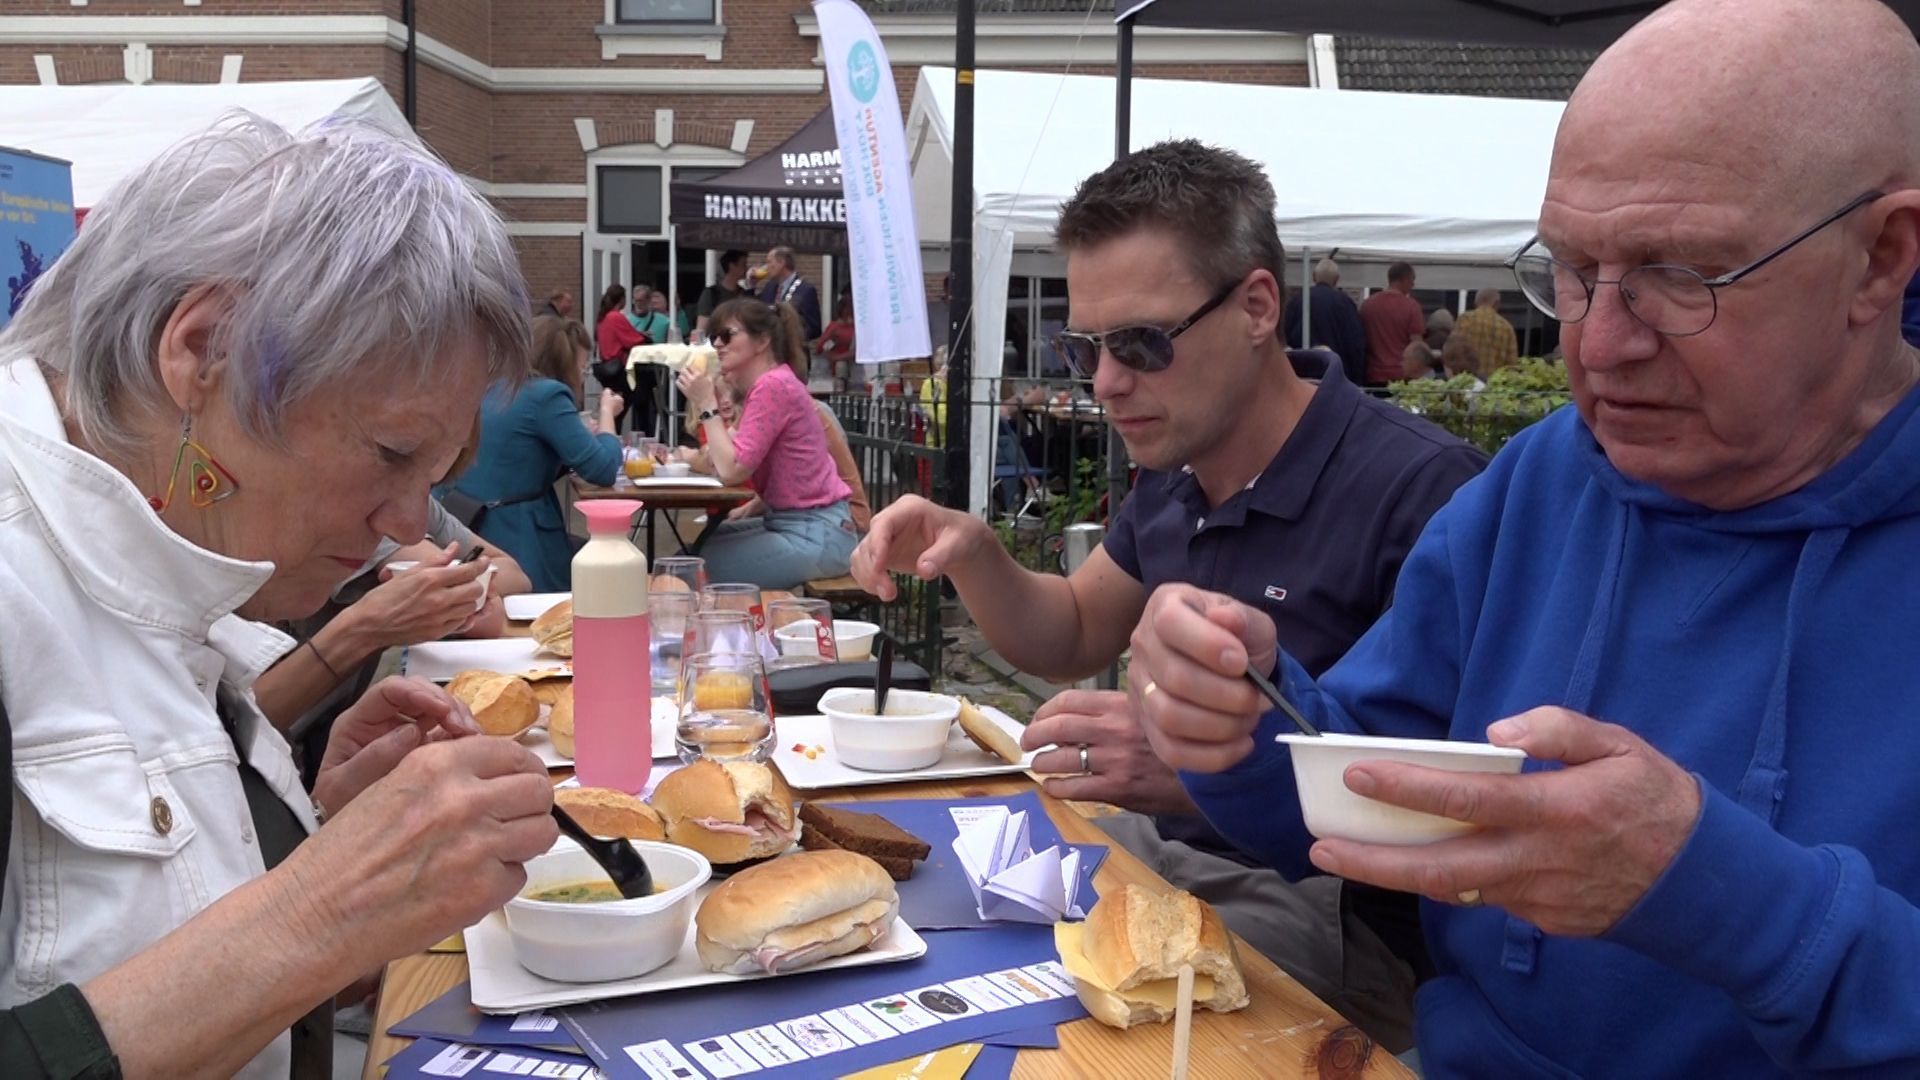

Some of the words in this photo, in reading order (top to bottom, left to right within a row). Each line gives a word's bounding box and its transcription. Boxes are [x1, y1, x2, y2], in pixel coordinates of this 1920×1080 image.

[781, 149, 842, 169] HARM
[703, 194, 772, 221] HARM
[776, 197, 847, 223] TAKKE
